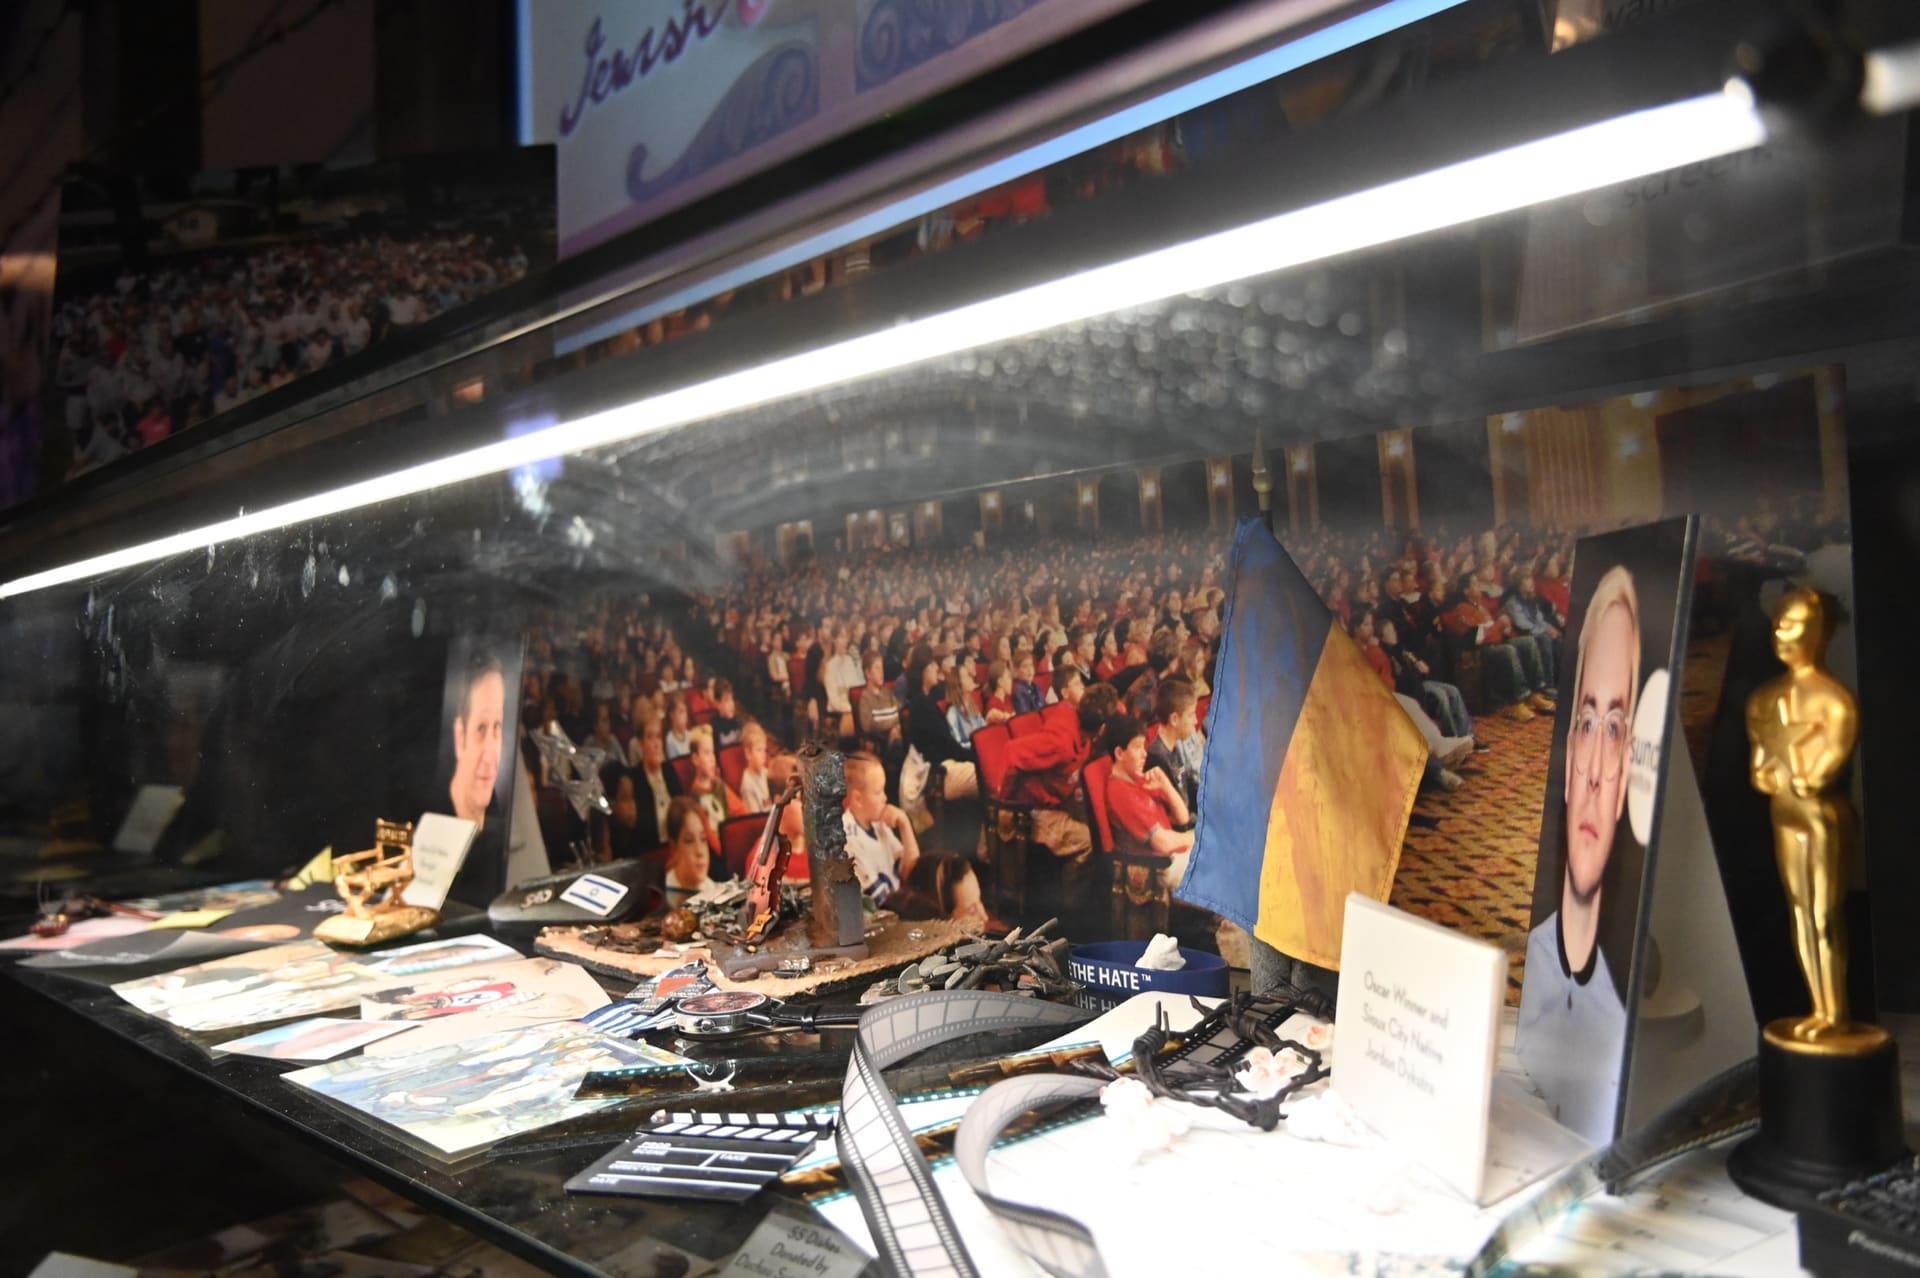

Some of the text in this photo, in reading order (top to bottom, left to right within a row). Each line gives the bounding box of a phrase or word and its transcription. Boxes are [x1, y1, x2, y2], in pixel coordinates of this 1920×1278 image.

[1071, 962, 1096, 983] THE
[1099, 966, 1140, 991] HATE
[1364, 970, 1449, 1030] Oscar Winner and
[1388, 1016, 1409, 1049] City
